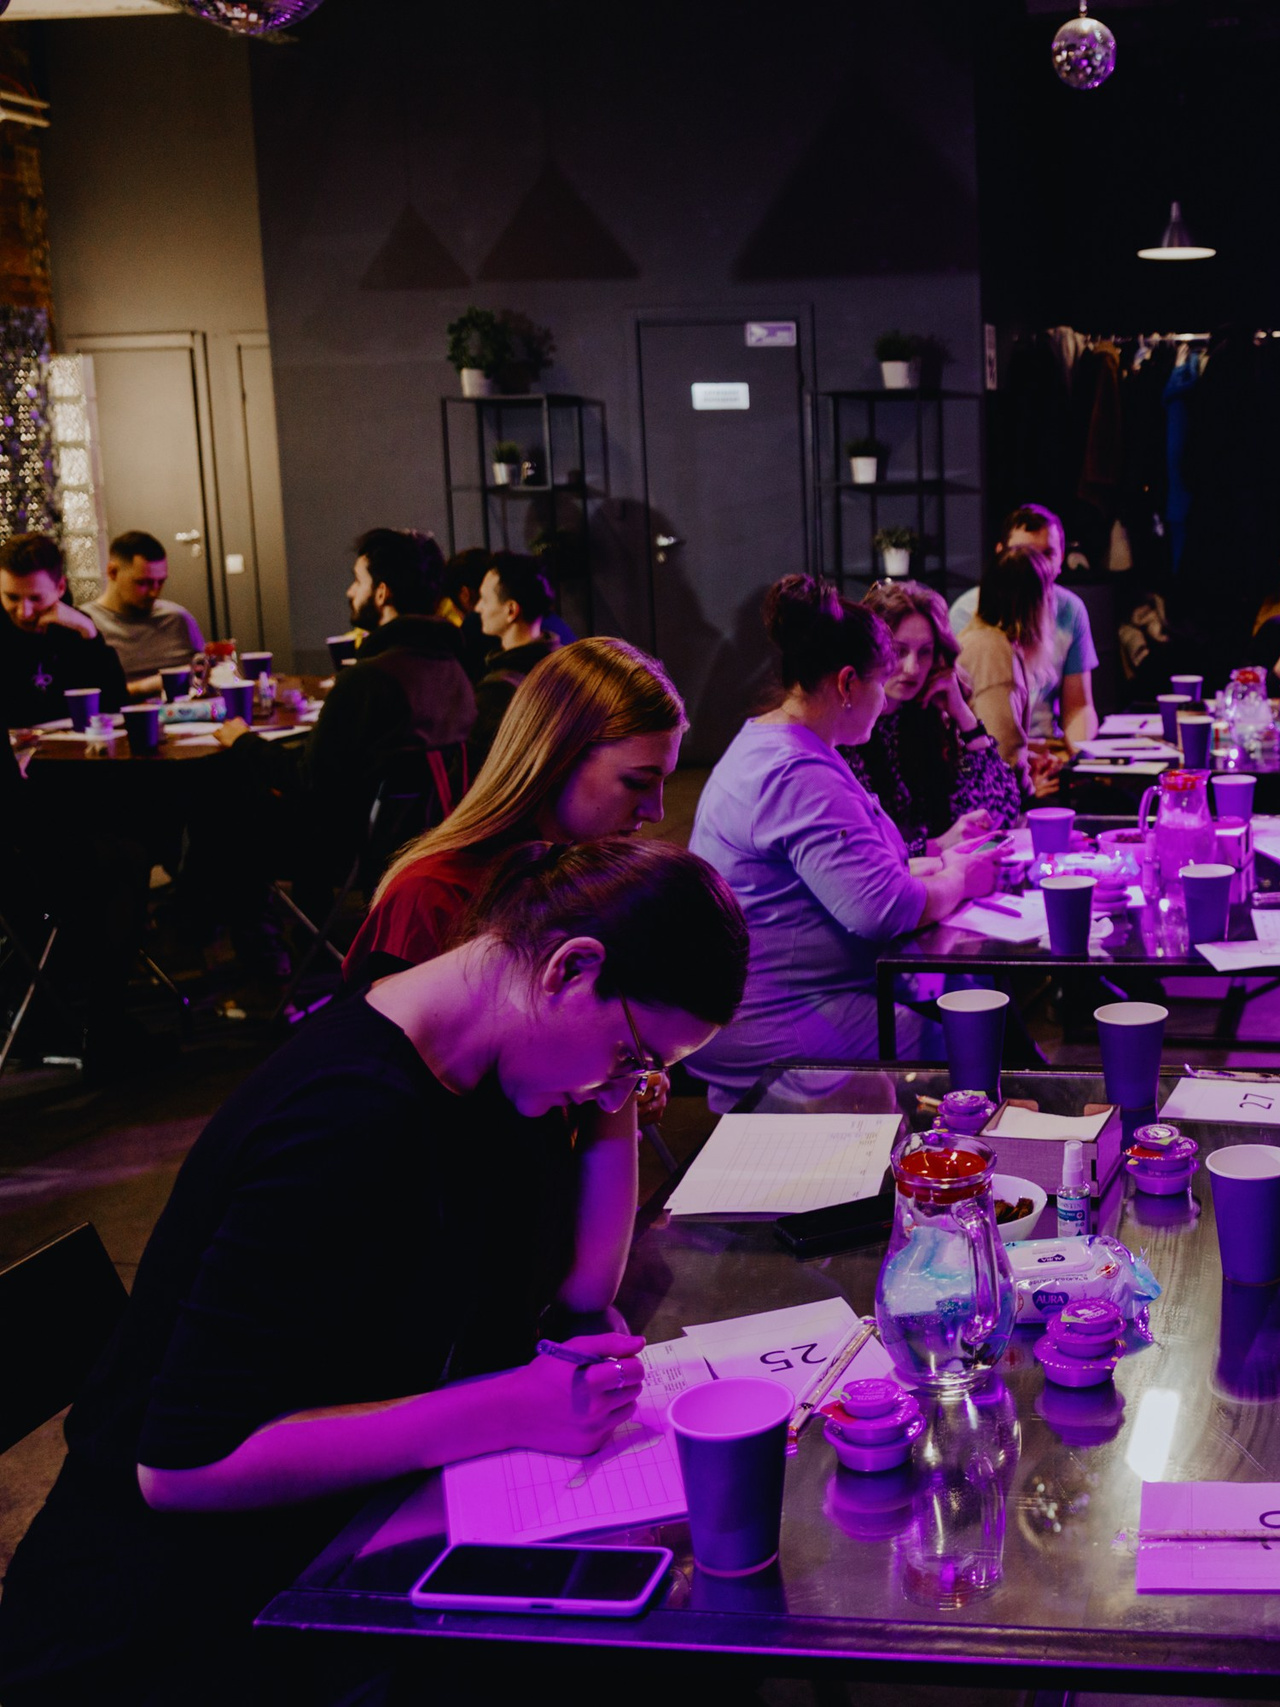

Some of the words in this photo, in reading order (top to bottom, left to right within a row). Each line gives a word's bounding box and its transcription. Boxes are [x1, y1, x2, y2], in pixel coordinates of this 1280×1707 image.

[1239, 1093, 1275, 1110] 27
[1035, 1294, 1065, 1304] AURA
[759, 1342, 828, 1373] 25
